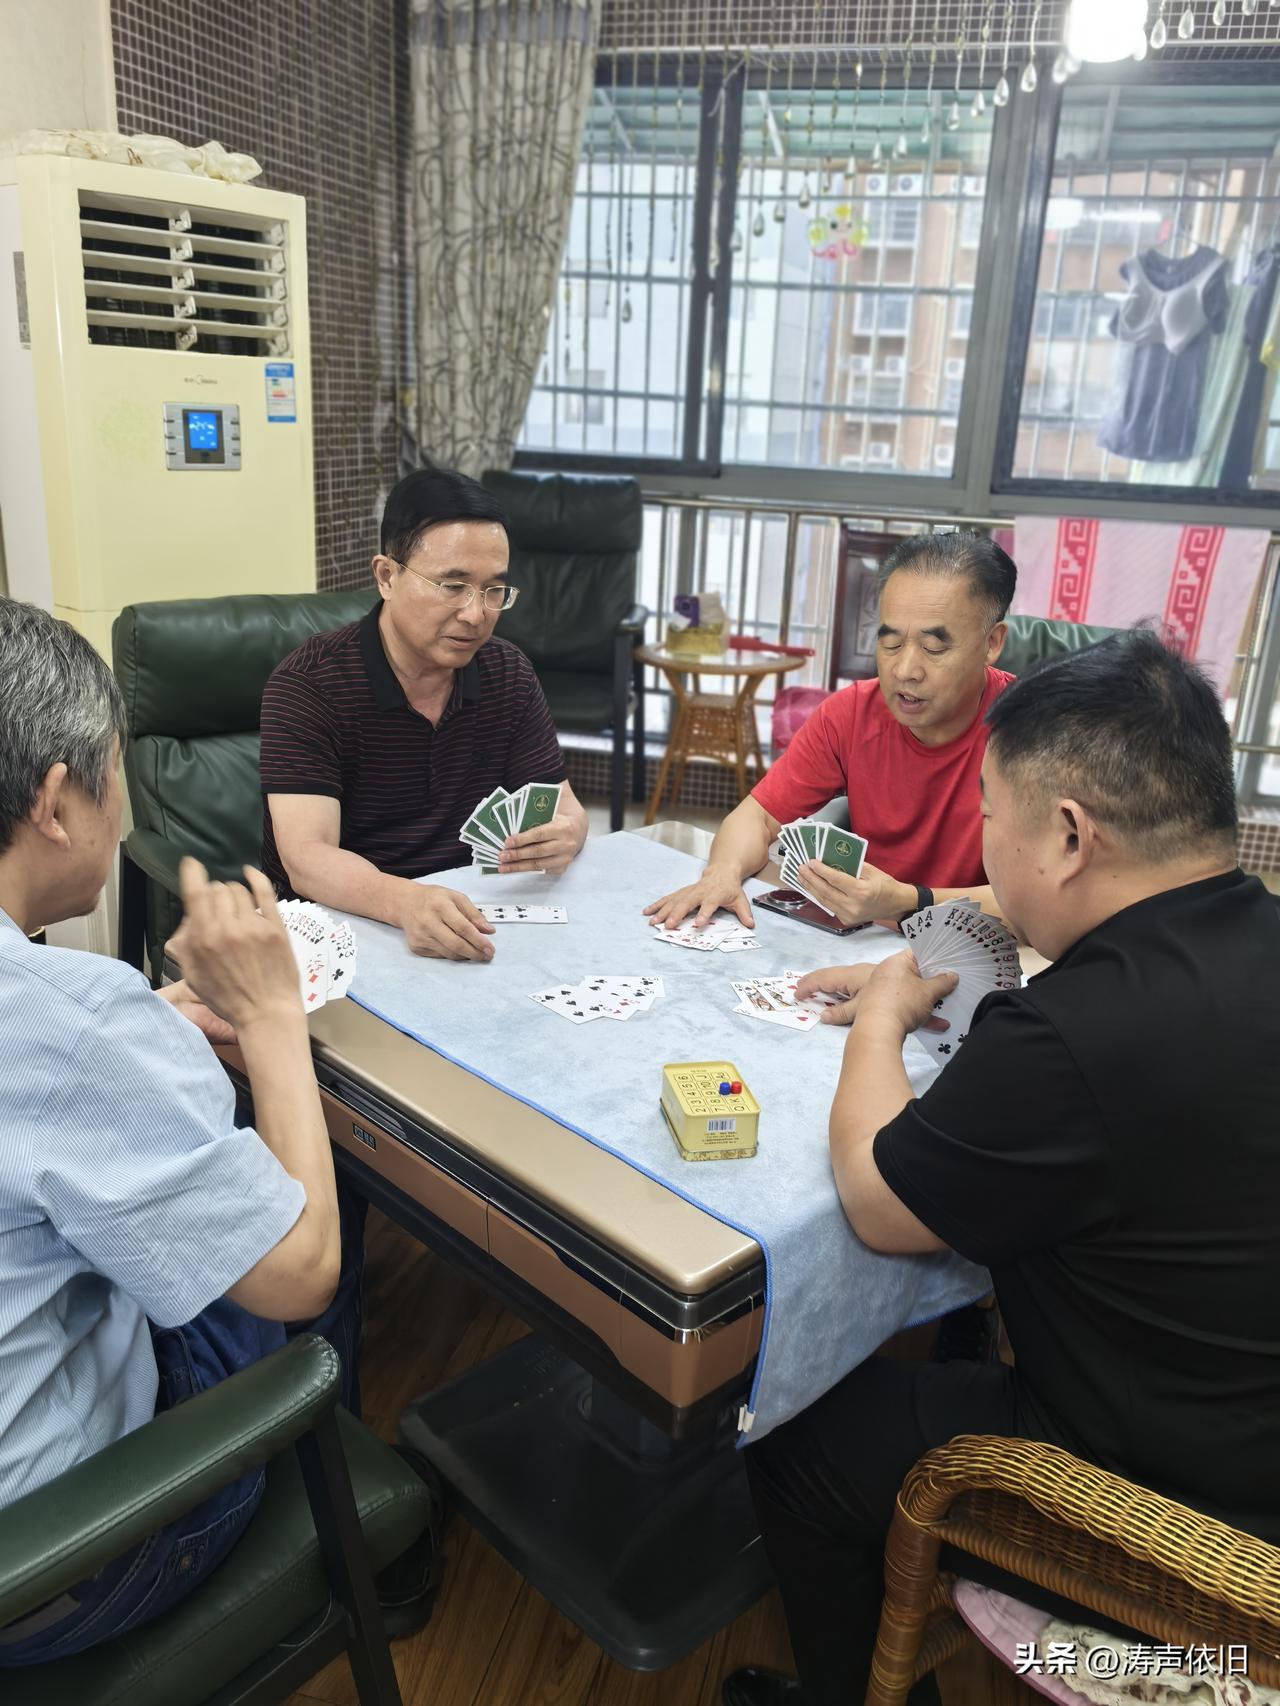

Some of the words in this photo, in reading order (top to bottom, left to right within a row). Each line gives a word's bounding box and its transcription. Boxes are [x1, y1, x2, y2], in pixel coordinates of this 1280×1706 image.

[926, 911, 933, 921] A
[948, 909, 959, 919] K
[962, 914, 974, 925] K
[907, 924, 914, 933] A
[991, 937, 1003, 946] 8
